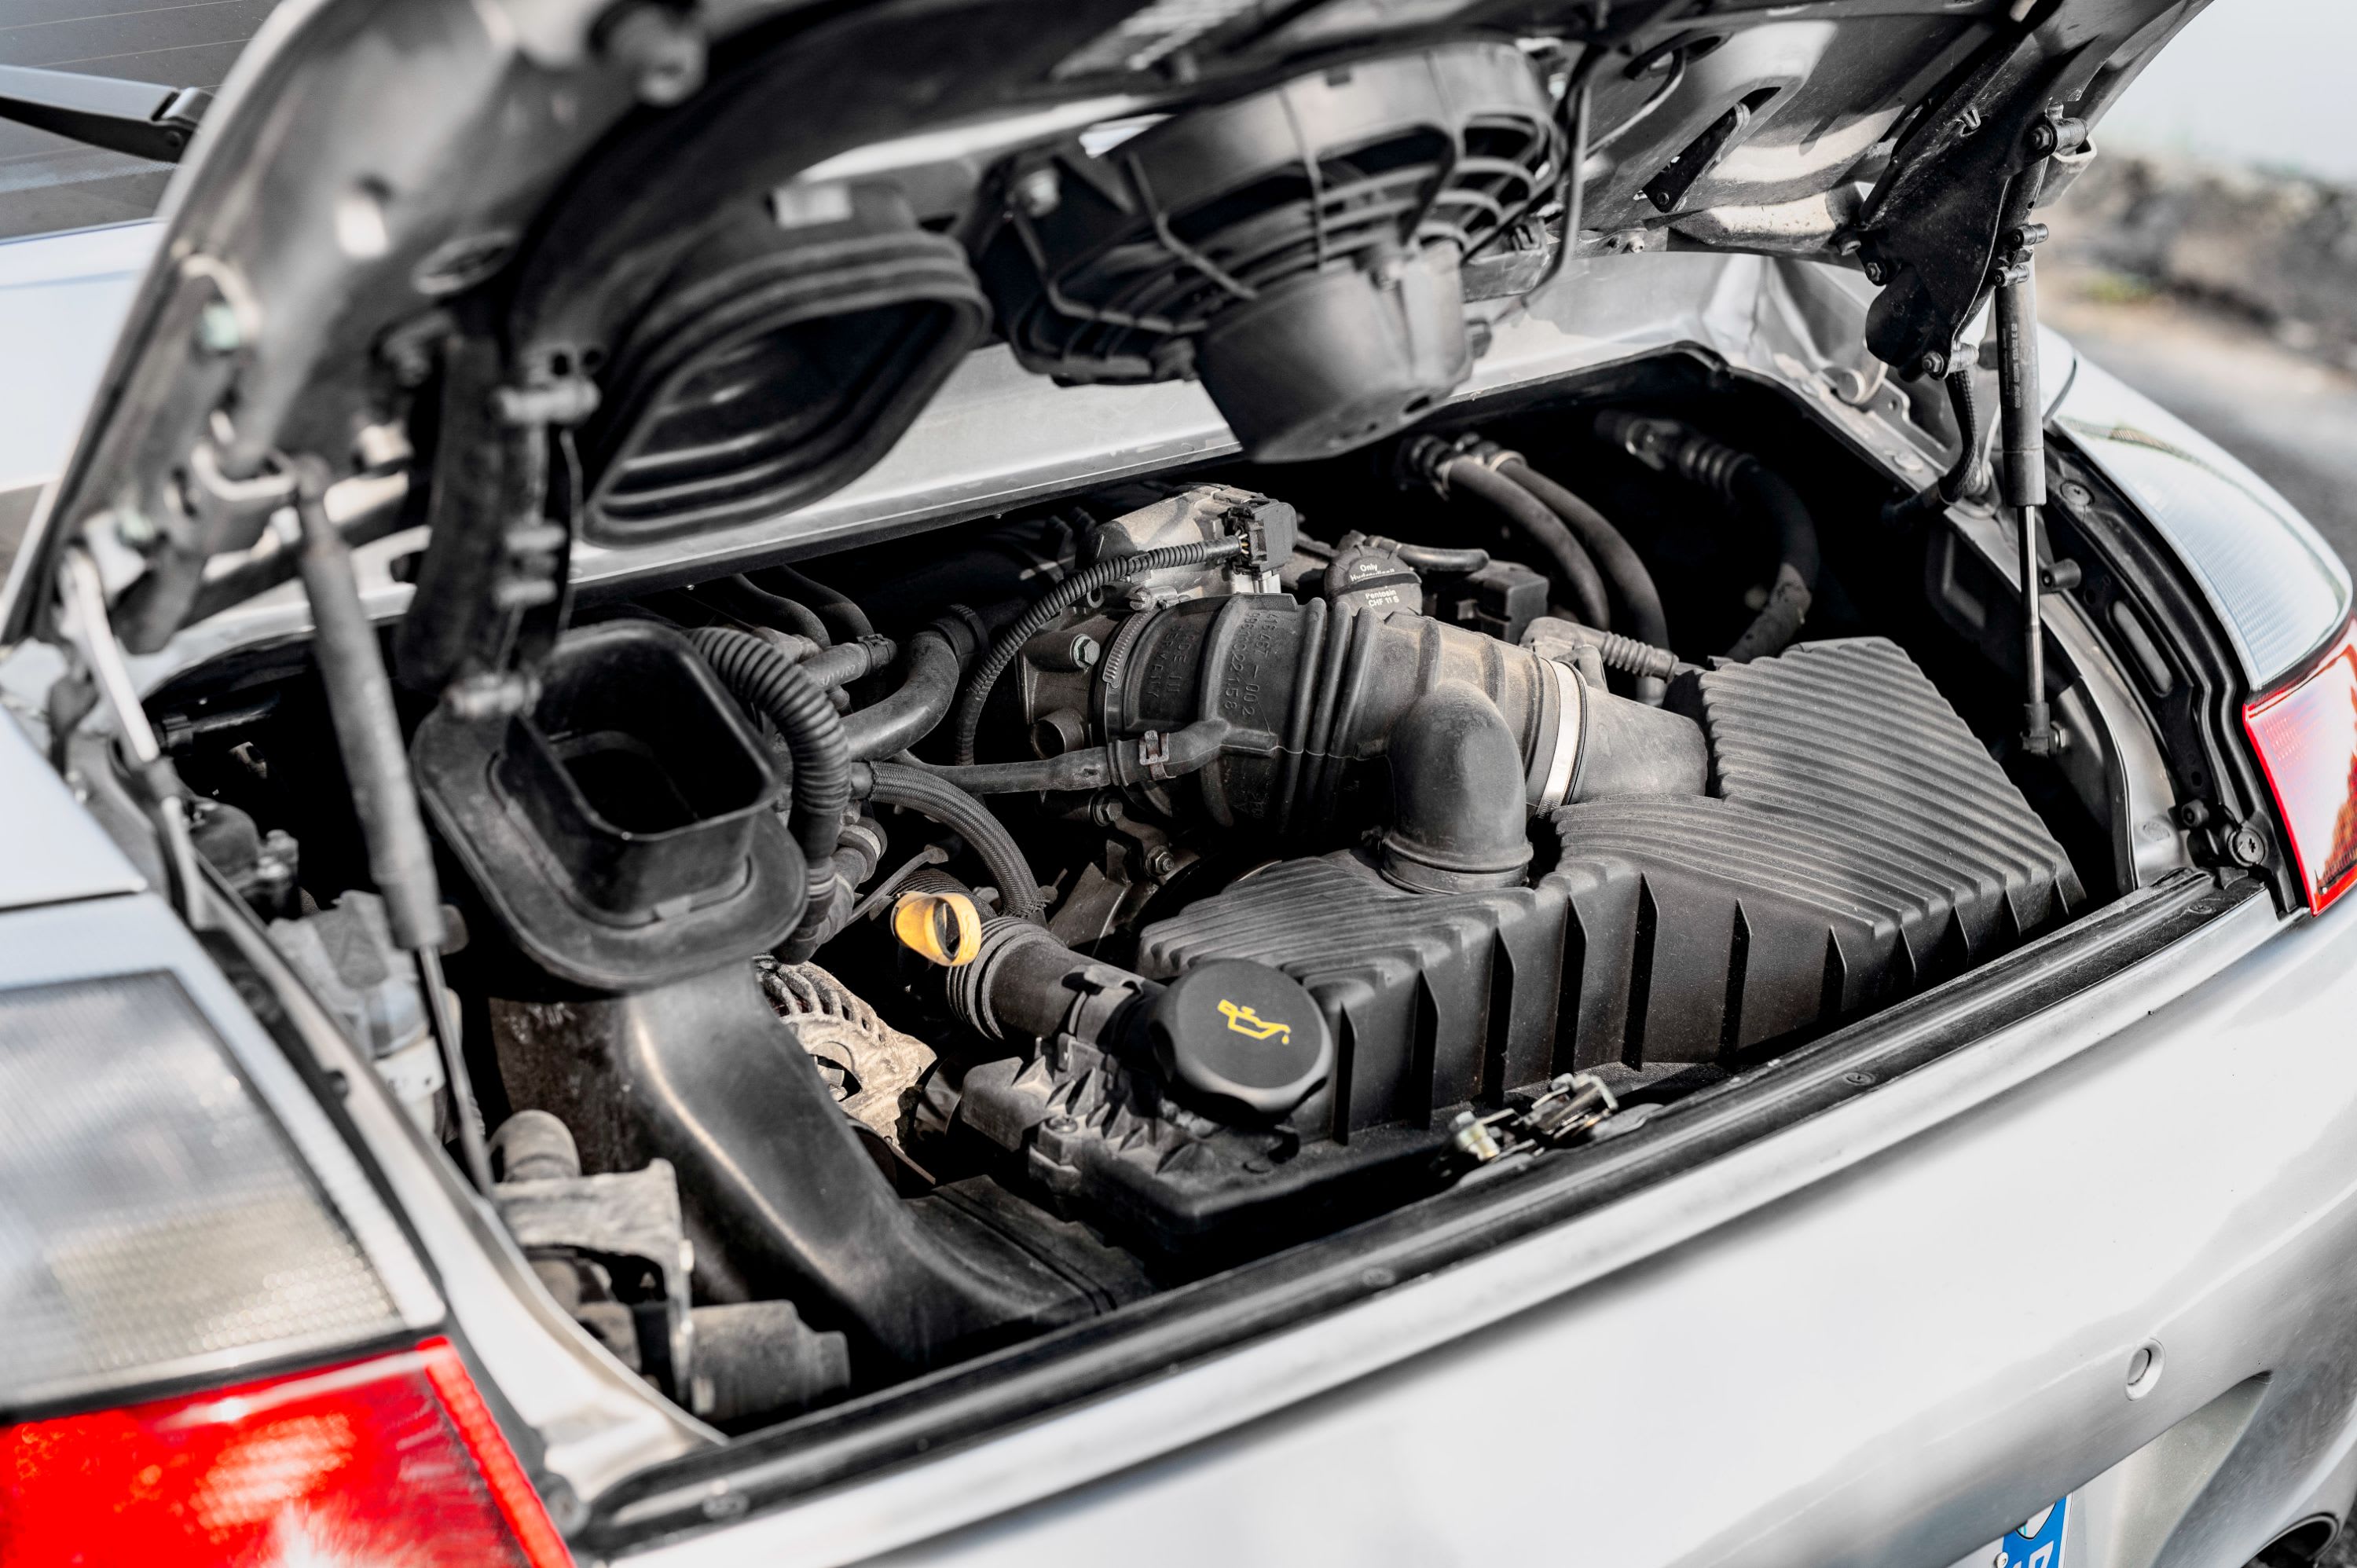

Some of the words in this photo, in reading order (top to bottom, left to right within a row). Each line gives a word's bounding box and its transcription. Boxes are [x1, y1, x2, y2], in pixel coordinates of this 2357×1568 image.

[1359, 562, 1378, 572] Only
[1365, 589, 1397, 599] Pentosin
[1368, 598, 1384, 606] CHF
